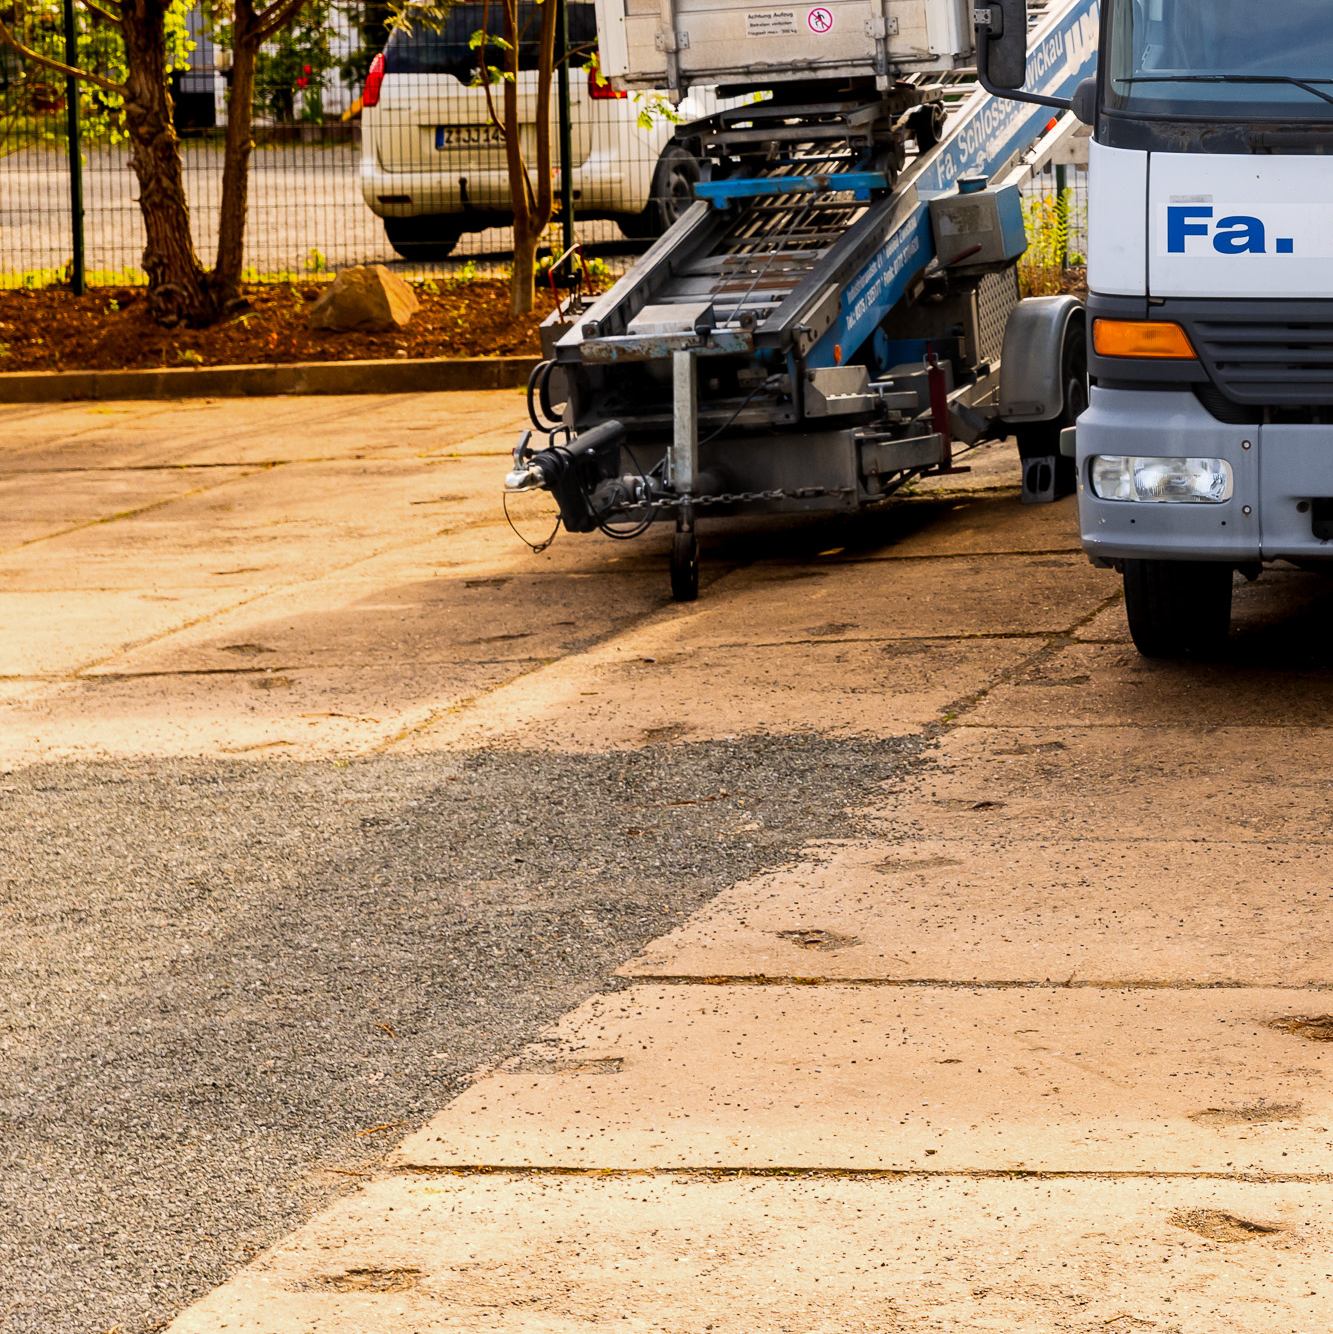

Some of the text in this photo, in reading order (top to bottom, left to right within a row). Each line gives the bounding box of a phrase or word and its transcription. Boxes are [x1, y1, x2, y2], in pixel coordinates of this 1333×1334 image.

[936, 149, 958, 190] Fa.
[957, 97, 1018, 164] Schlosse
[1019, 30, 1064, 93] wickau
[445, 129, 454, 144] Z
[1166, 205, 1294, 254] Fa.
